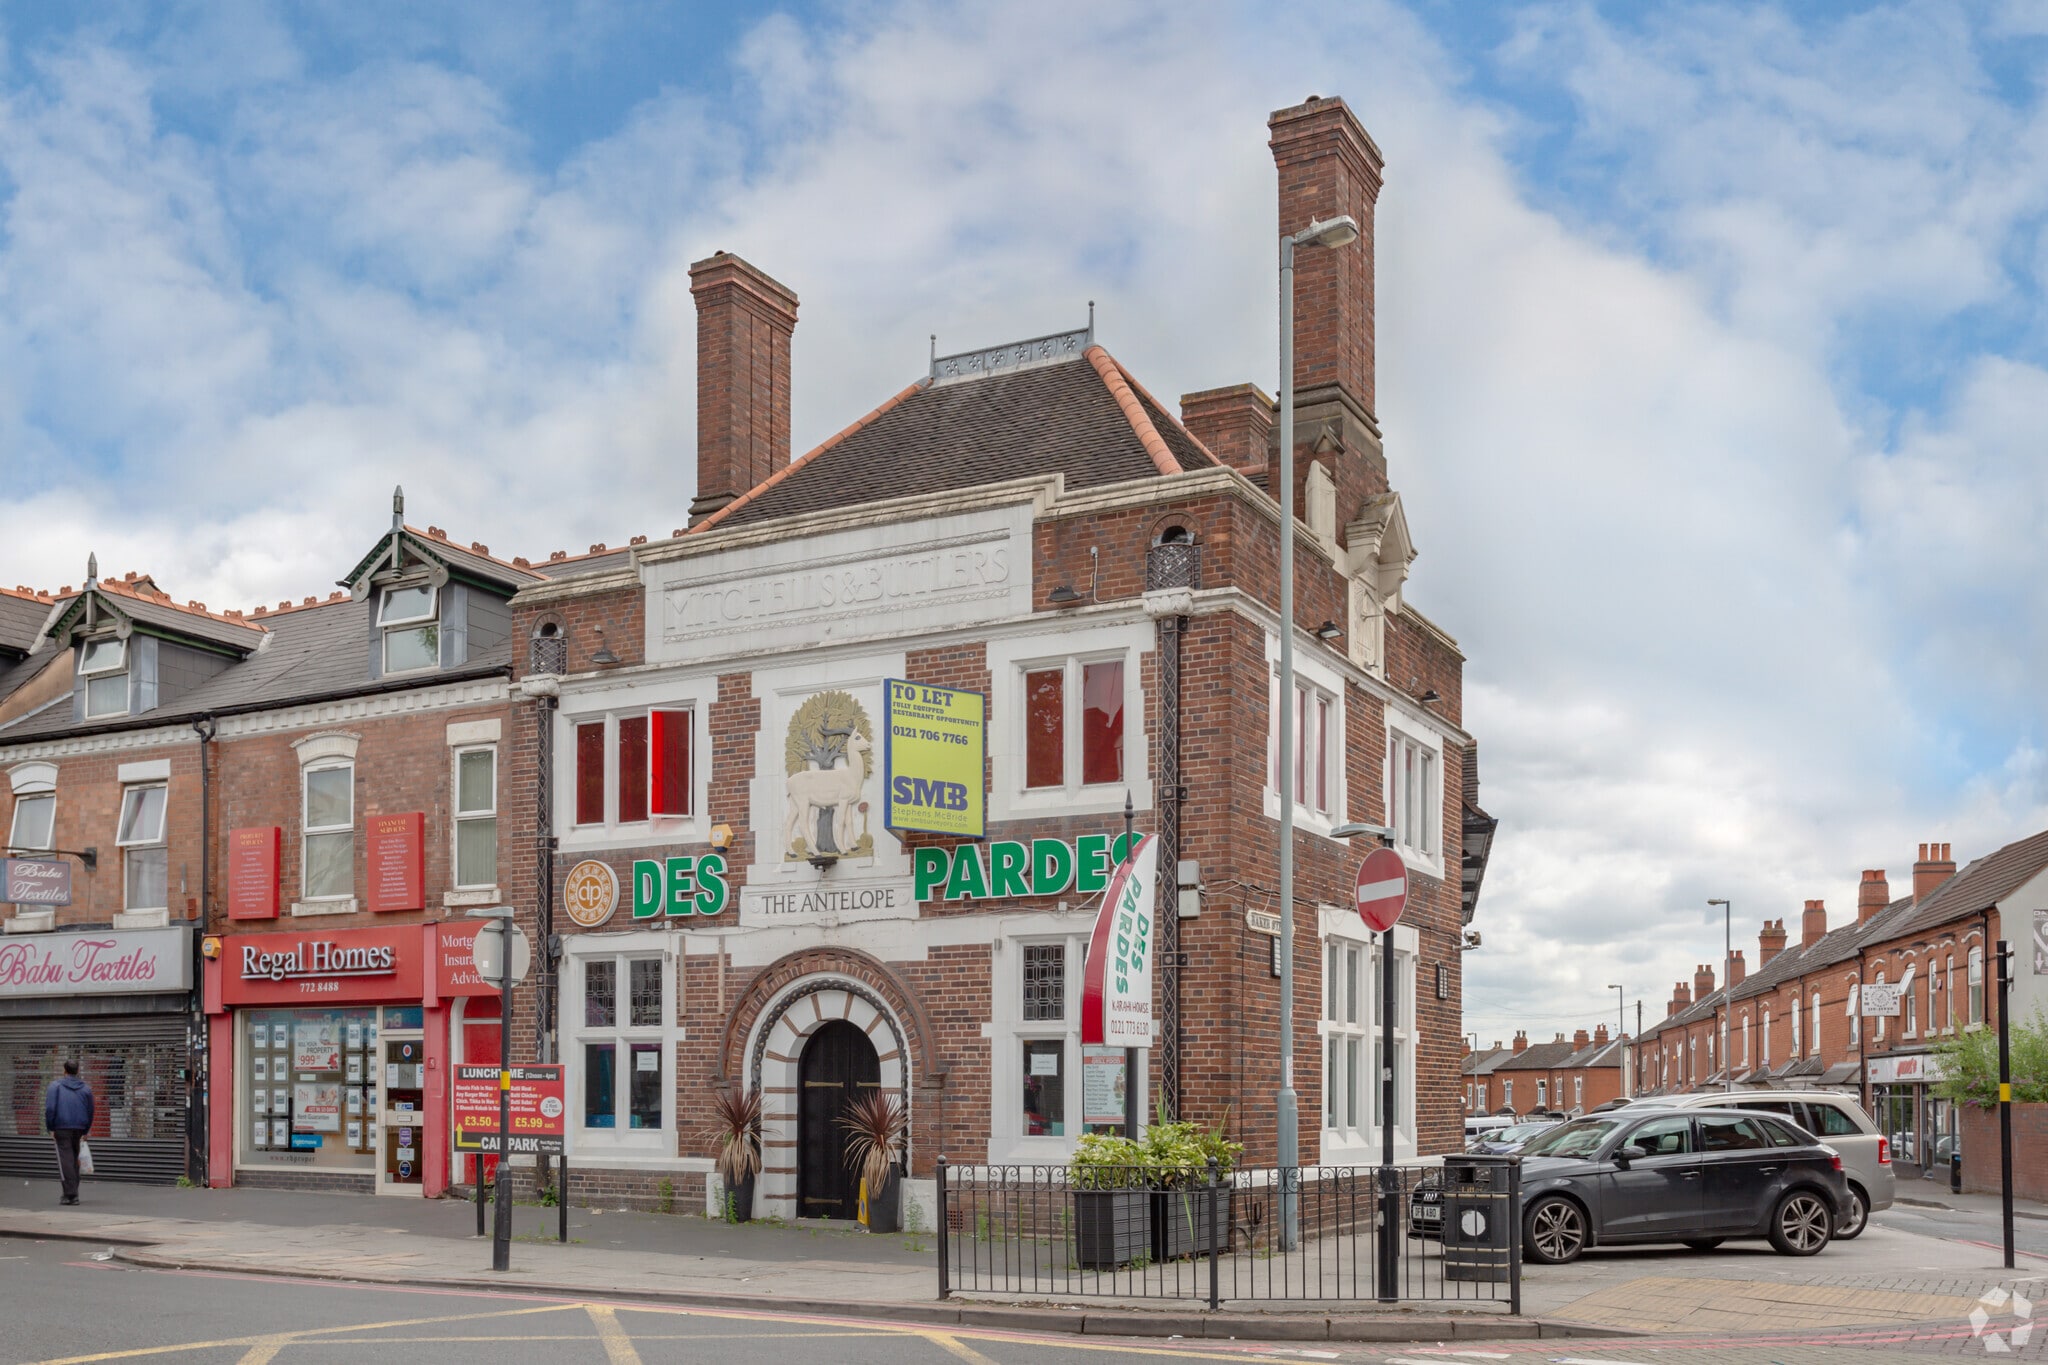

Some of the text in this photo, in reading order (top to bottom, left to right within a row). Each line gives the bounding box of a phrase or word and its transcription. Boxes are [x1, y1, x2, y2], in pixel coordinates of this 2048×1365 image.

[893, 684, 954, 707] TO LET
[893, 702, 945, 715] FULLY EQUIPPED
[893, 709, 980, 728] RESTAURANT OPPORTUNITY
[893, 725, 968, 746] 0121 706 7766
[893, 775, 968, 811] SMB
[893, 806, 968, 823] Stephens McBride
[893, 816, 969, 829] www.smbsurveyors.com
[14, 863, 64, 879] Babu
[10, 881, 68, 902] Textiles
[632, 853, 729, 919] DES
[762, 889, 895, 914] THE ANTELOPE
[1115, 872, 1142, 995] PARDES
[442, 935, 474, 950] Mortg
[1131, 911, 1150, 974] DES
[0, 939, 157, 985] Babu Textiles
[241, 940, 393, 981] Regal Homes
[444, 954, 474, 967] Insura
[300, 981, 339, 993] 772 8488
[1111, 999, 1149, 1013] KARAHI HOUSE
[1111, 1019, 1125, 1034] 0121
[462, 1067, 524, 1079] LUNCHTME
[464, 1116, 492, 1127] £3.50
[515, 1117, 543, 1128] £5.99
[508, 1137, 539, 1151] PARK
